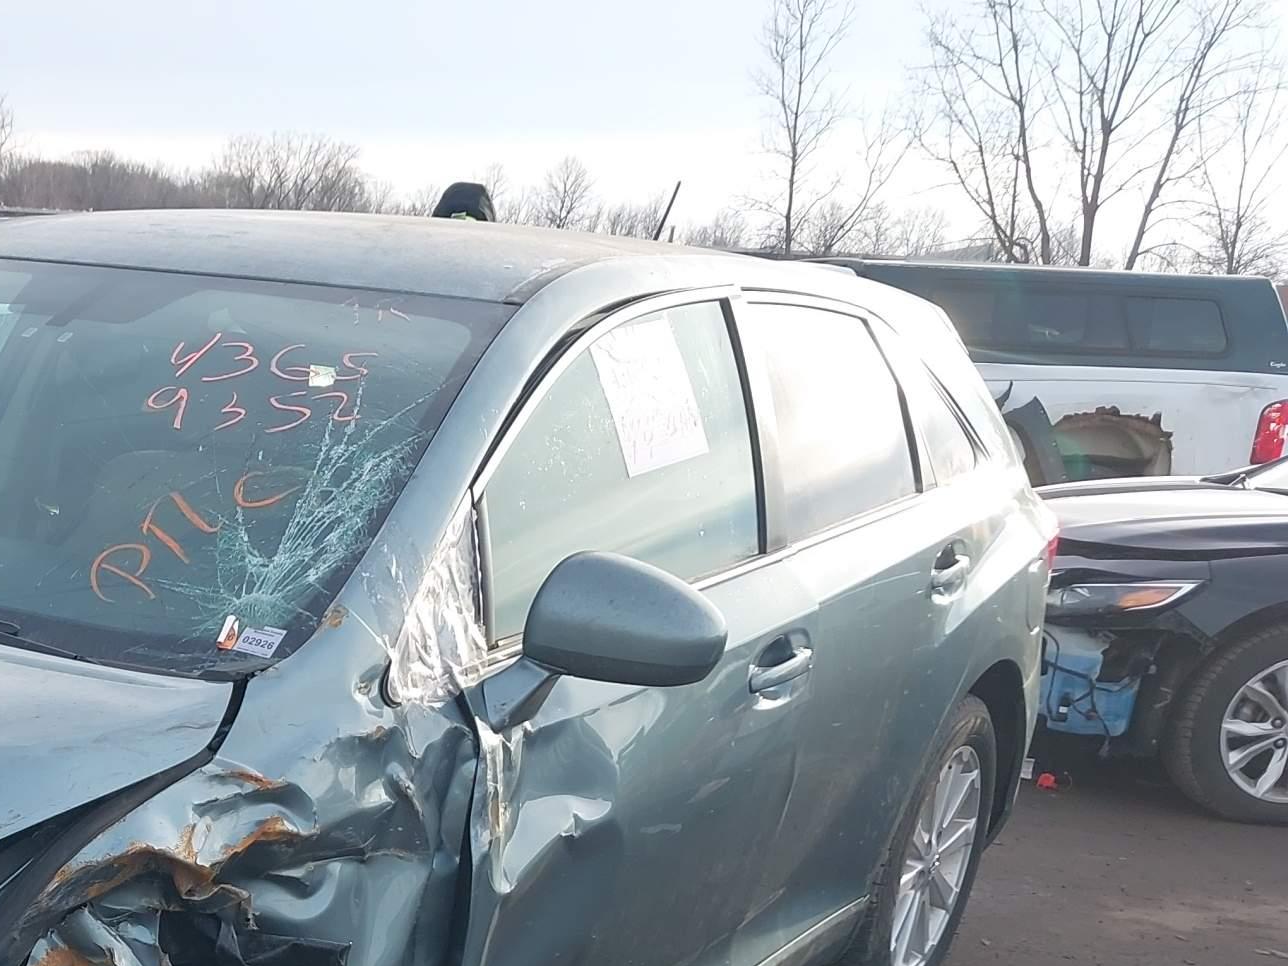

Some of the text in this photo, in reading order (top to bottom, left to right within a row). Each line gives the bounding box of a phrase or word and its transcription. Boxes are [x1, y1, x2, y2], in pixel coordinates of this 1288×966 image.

[170, 332, 378, 382] 4365
[146, 386, 361, 432] 9352
[242, 636, 275, 650] 02926
